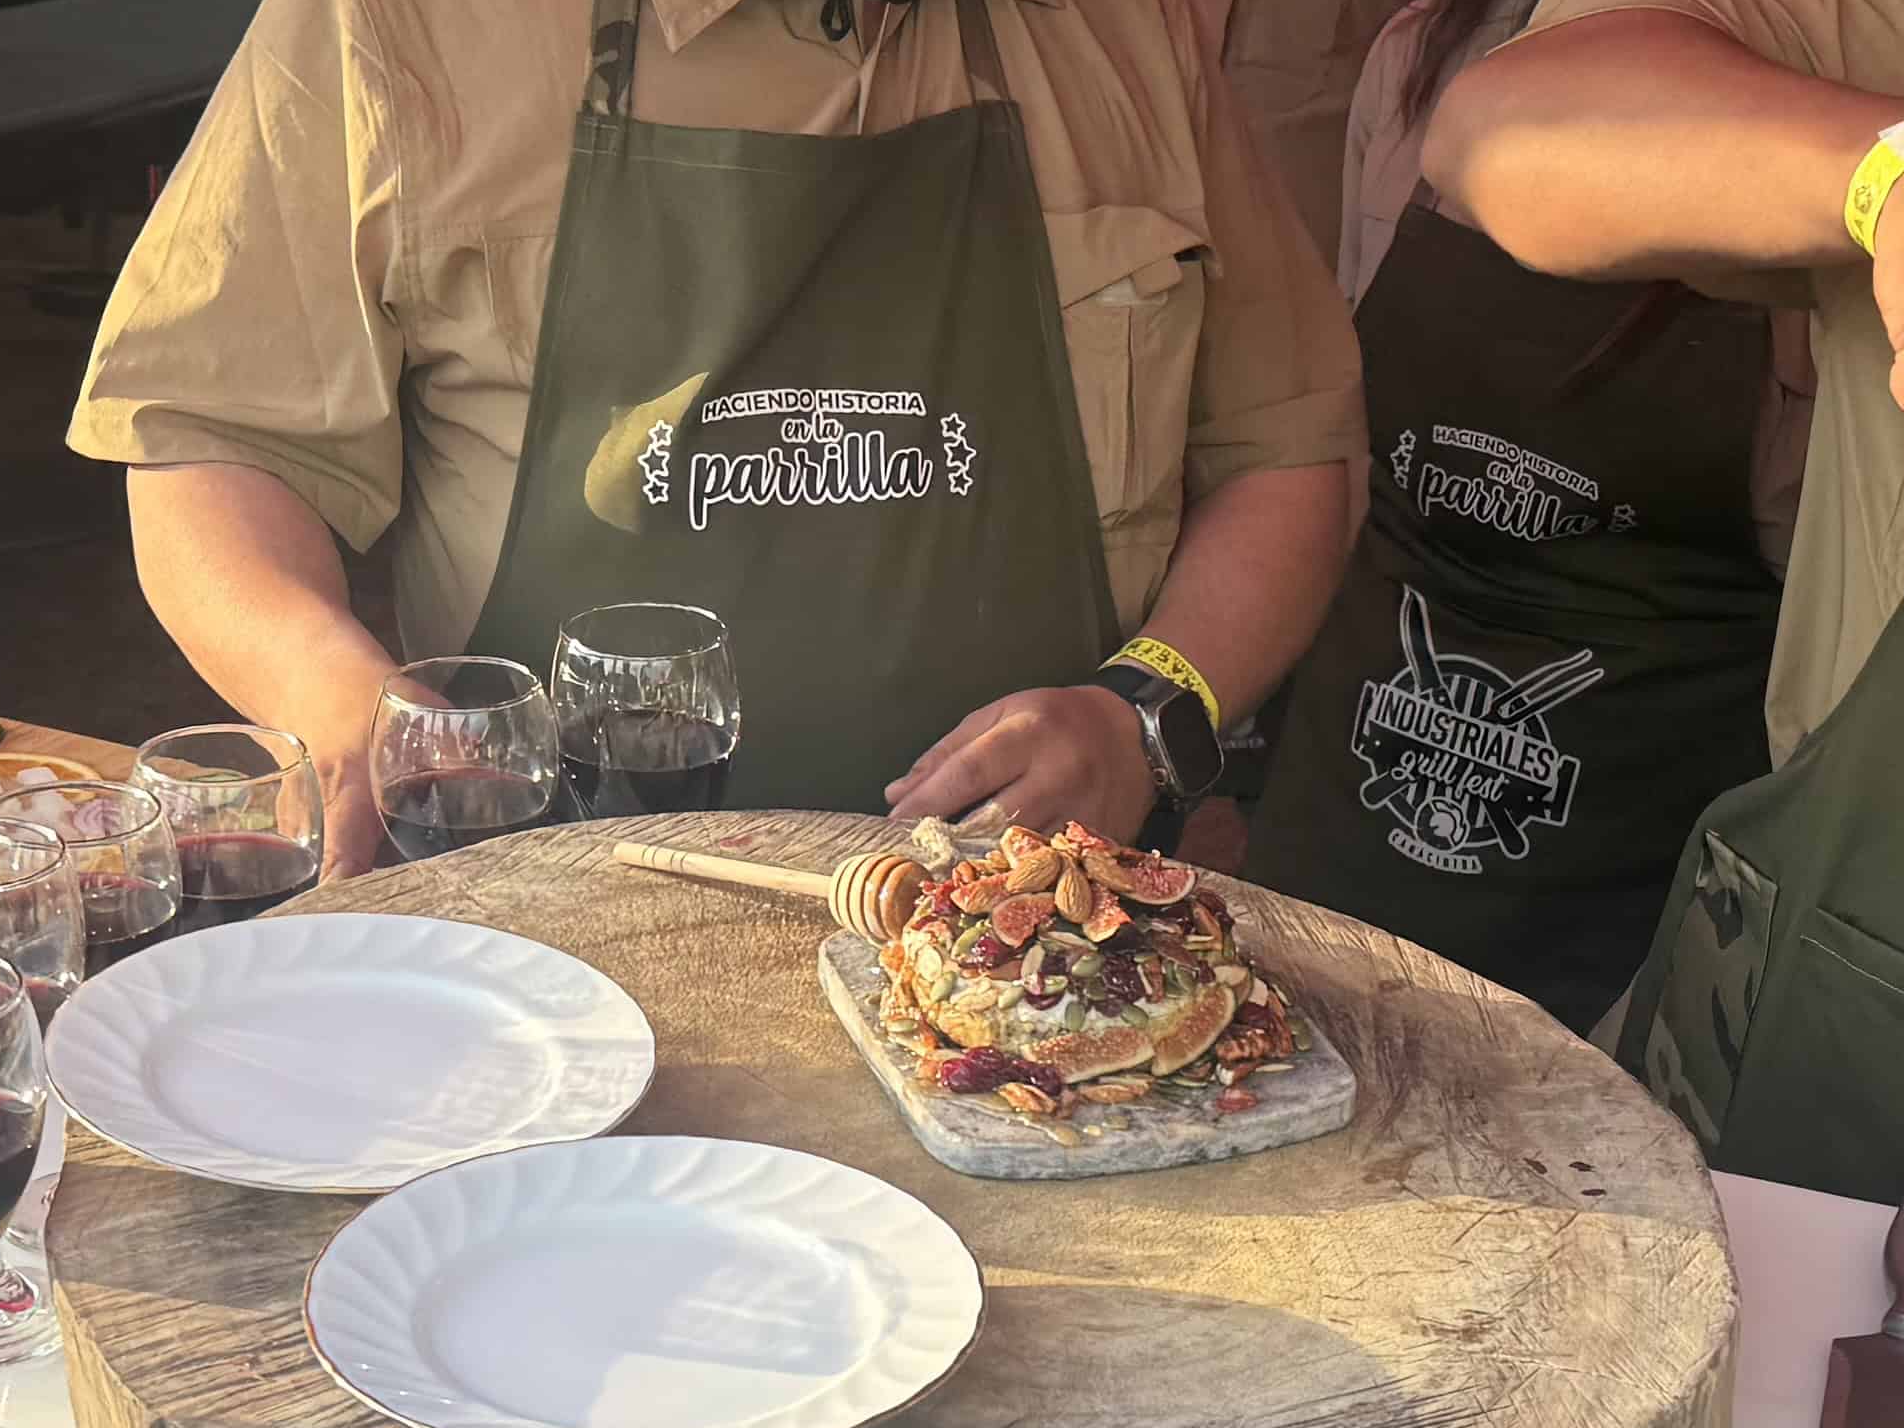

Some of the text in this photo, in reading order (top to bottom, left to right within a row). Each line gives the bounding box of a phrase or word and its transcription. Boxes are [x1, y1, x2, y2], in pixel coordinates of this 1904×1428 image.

[702, 389, 926, 422] HACIENDO HISTORIA
[781, 411, 844, 443] en la
[689, 430, 933, 532] parrilla
[1417, 463, 1599, 541] parrilla
[1432, 424, 1600, 502] HACIENDO HISTORIA
[1375, 687, 1556, 782] INDUSTRIALES
[1391, 748, 1510, 803] grill fest
